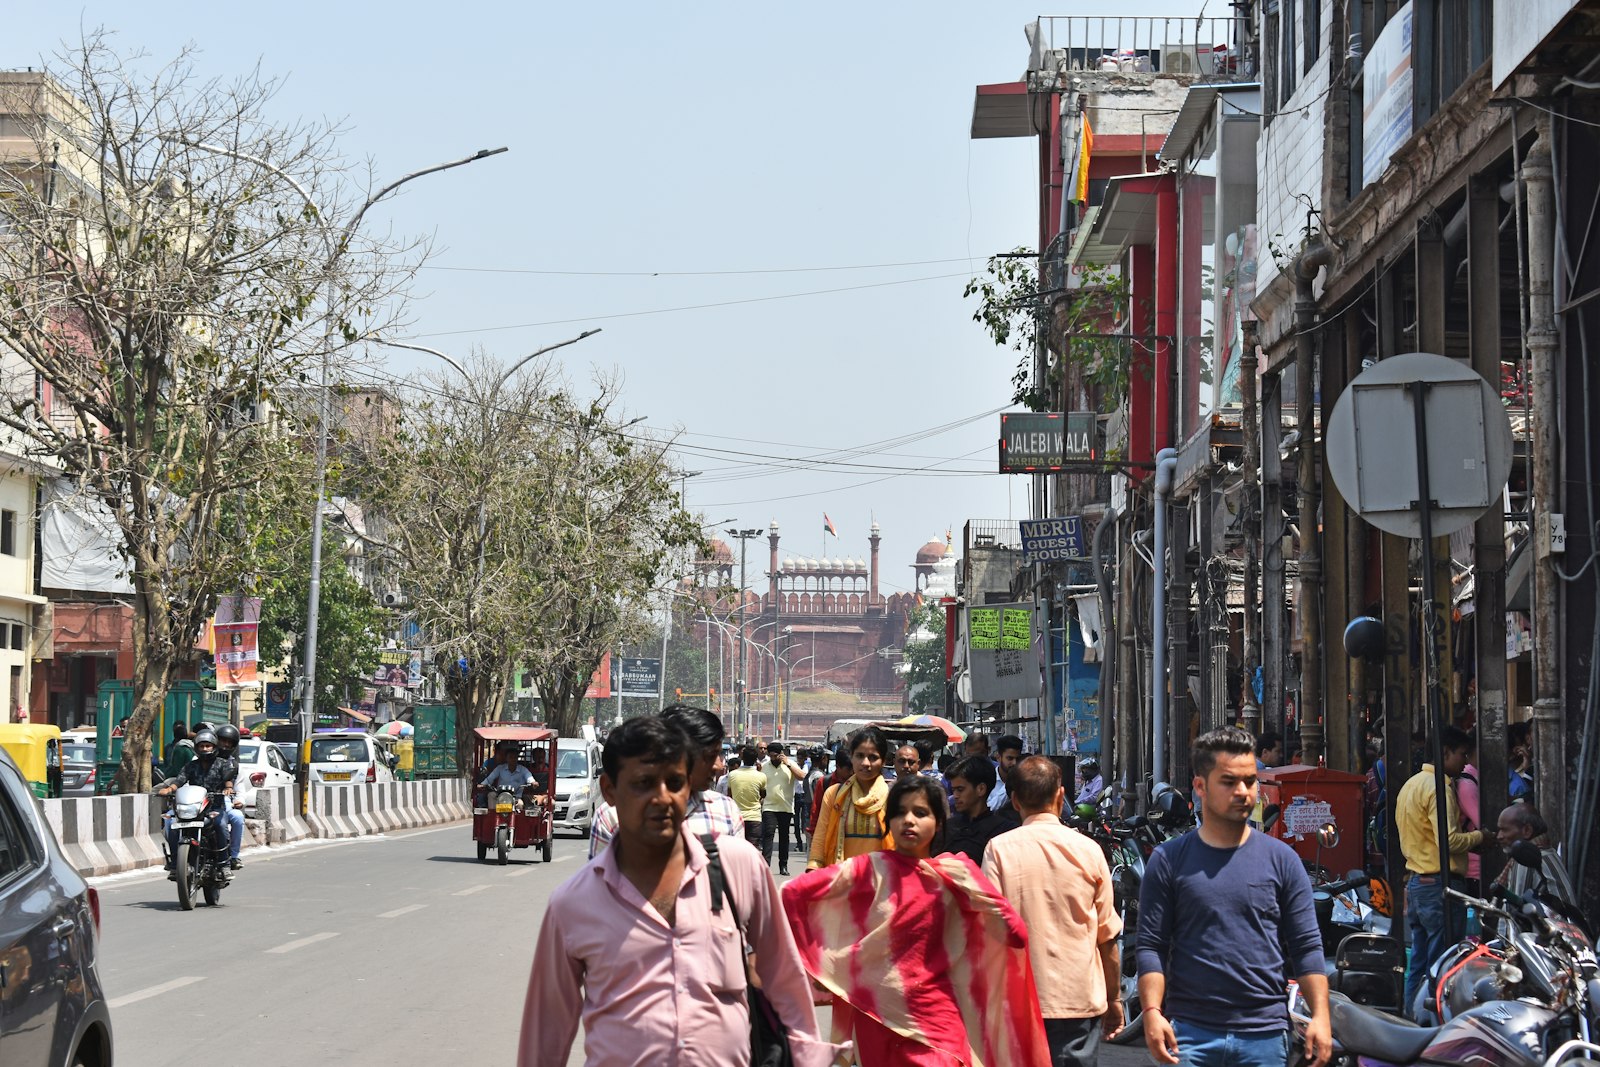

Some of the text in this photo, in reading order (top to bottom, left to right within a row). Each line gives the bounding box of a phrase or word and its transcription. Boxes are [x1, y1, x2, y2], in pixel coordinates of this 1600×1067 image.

[1008, 432, 1090, 453] JALEBI WALA
[1007, 457, 1045, 466] DARIBA
[1023, 519, 1076, 538] MERU
[1026, 537, 1077, 550] GUEST
[1551, 535, 1564, 544] 78
[1026, 547, 1080, 560] HOUSE
